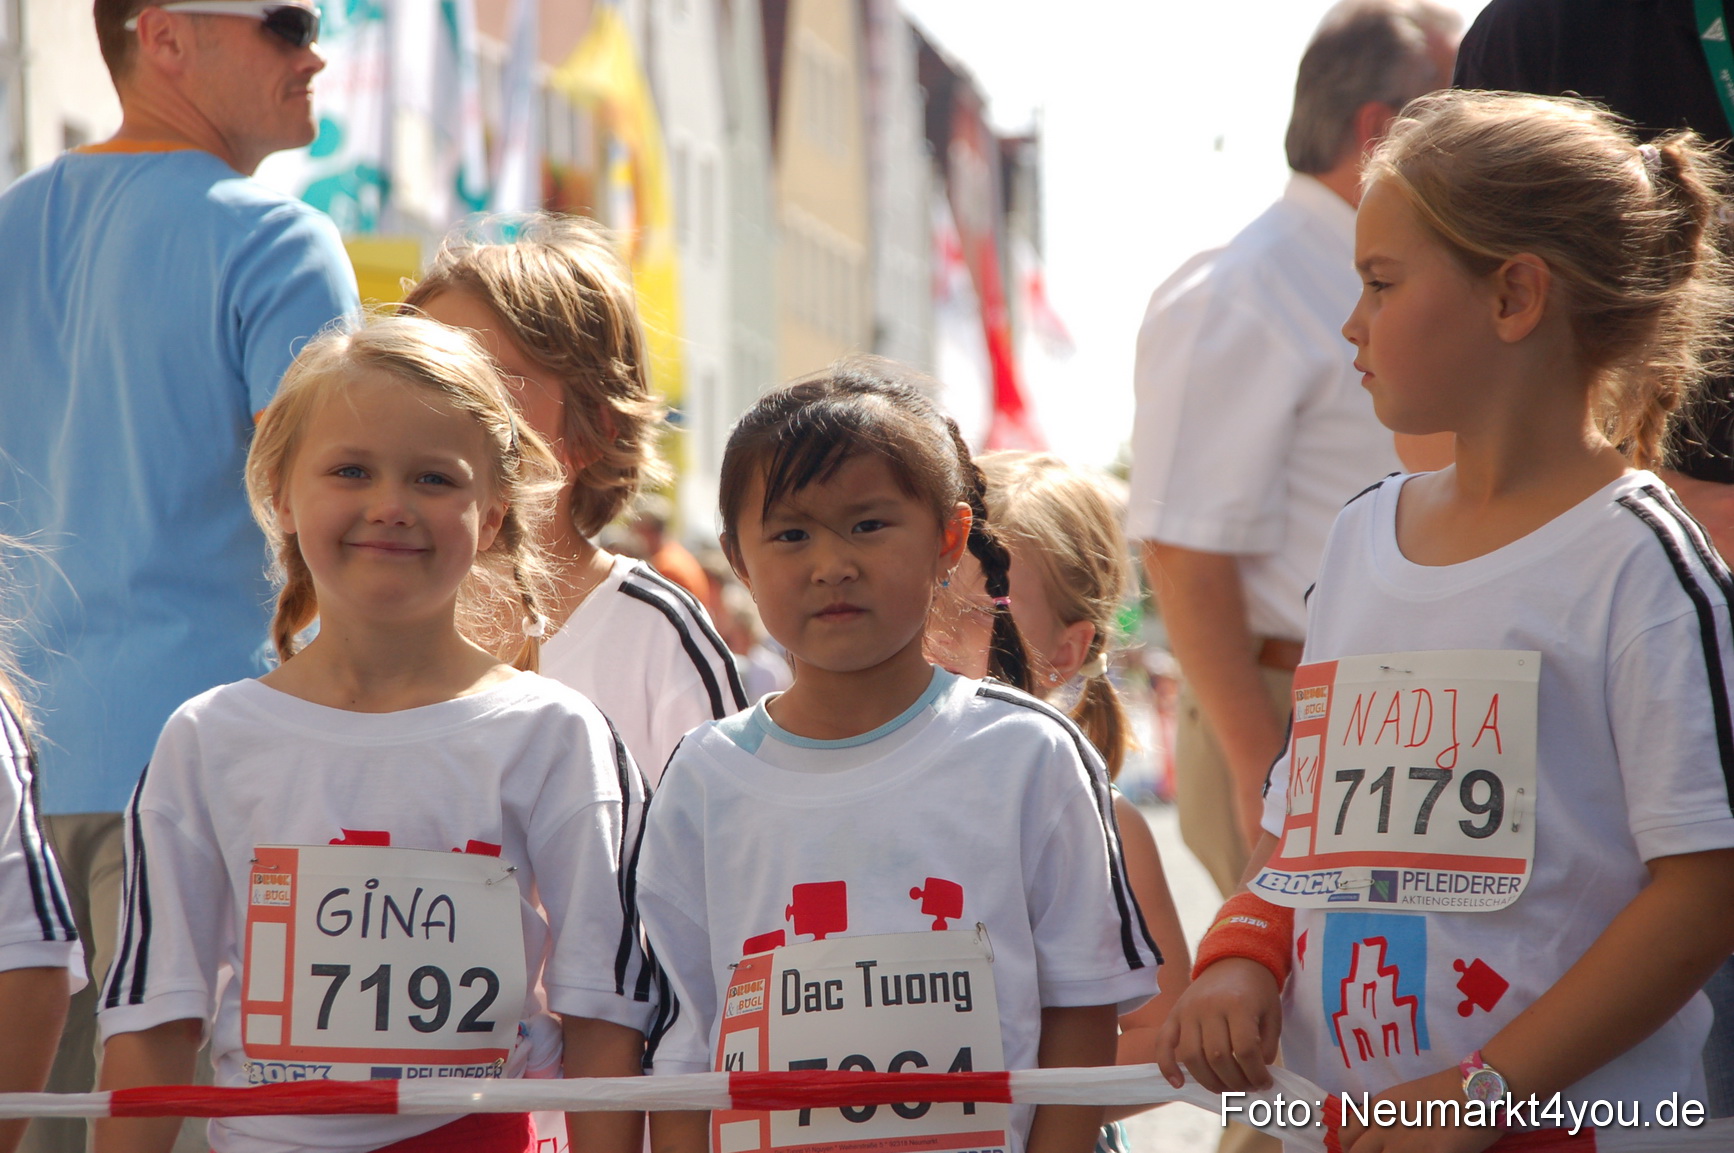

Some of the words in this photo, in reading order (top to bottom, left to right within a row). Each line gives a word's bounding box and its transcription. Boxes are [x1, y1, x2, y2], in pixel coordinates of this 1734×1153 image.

[1342, 688, 1502, 770] NADJA
[1294, 755, 1318, 797] K1
[1334, 766, 1505, 839] 7179
[1256, 871, 1343, 895] BOCK
[1402, 870, 1522, 895] PFLEIDERER
[1230, 916, 1268, 929] MERZ
[311, 963, 501, 1033] 7192
[781, 968, 844, 1016] Dac
[855, 960, 973, 1013] Tuong
